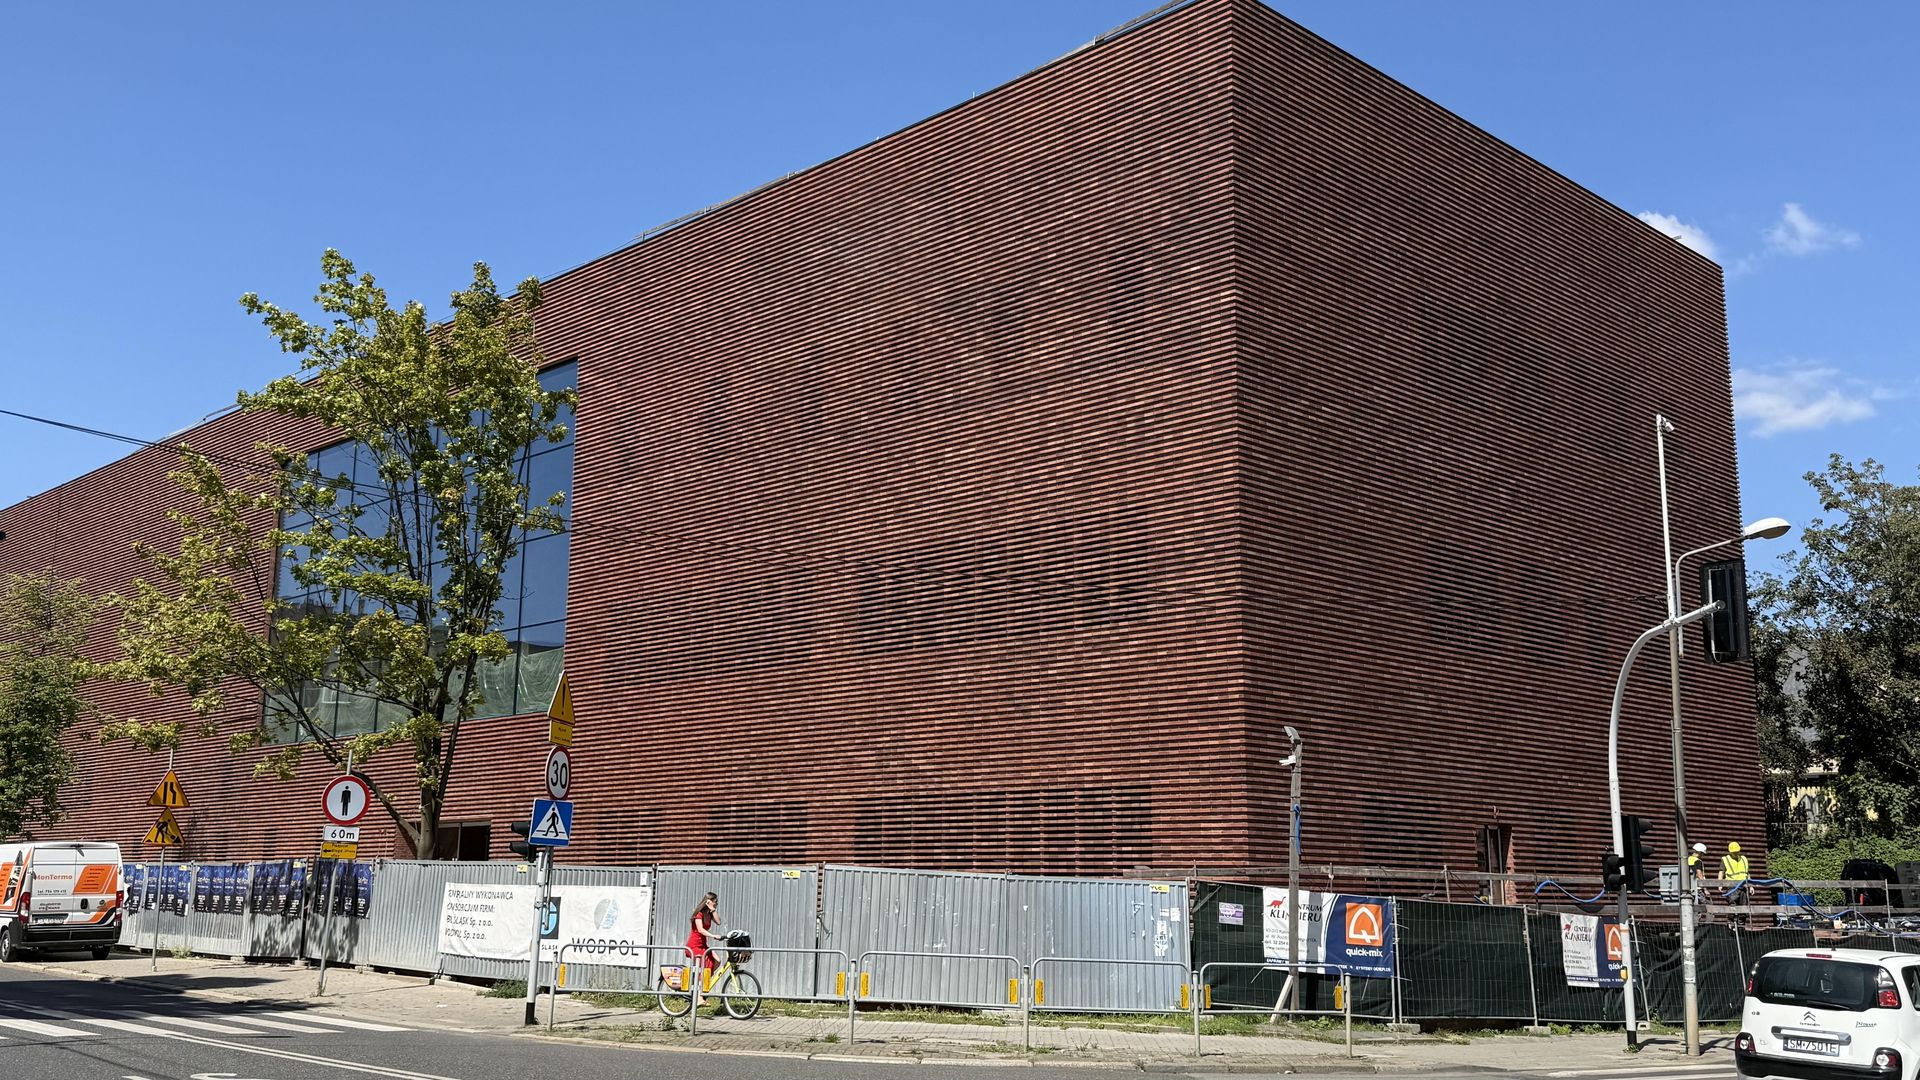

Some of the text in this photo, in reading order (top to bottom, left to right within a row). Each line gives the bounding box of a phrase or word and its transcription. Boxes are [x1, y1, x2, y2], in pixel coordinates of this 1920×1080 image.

[550, 760, 568, 789] 30
[476, 890, 514, 900] WYKONAWCA
[1298, 903, 1322, 912] NTRUM
[1270, 908, 1322, 922] KLINIERU
[571, 937, 639, 956] WODPOL
[1345, 947, 1383, 957] quick-mix
